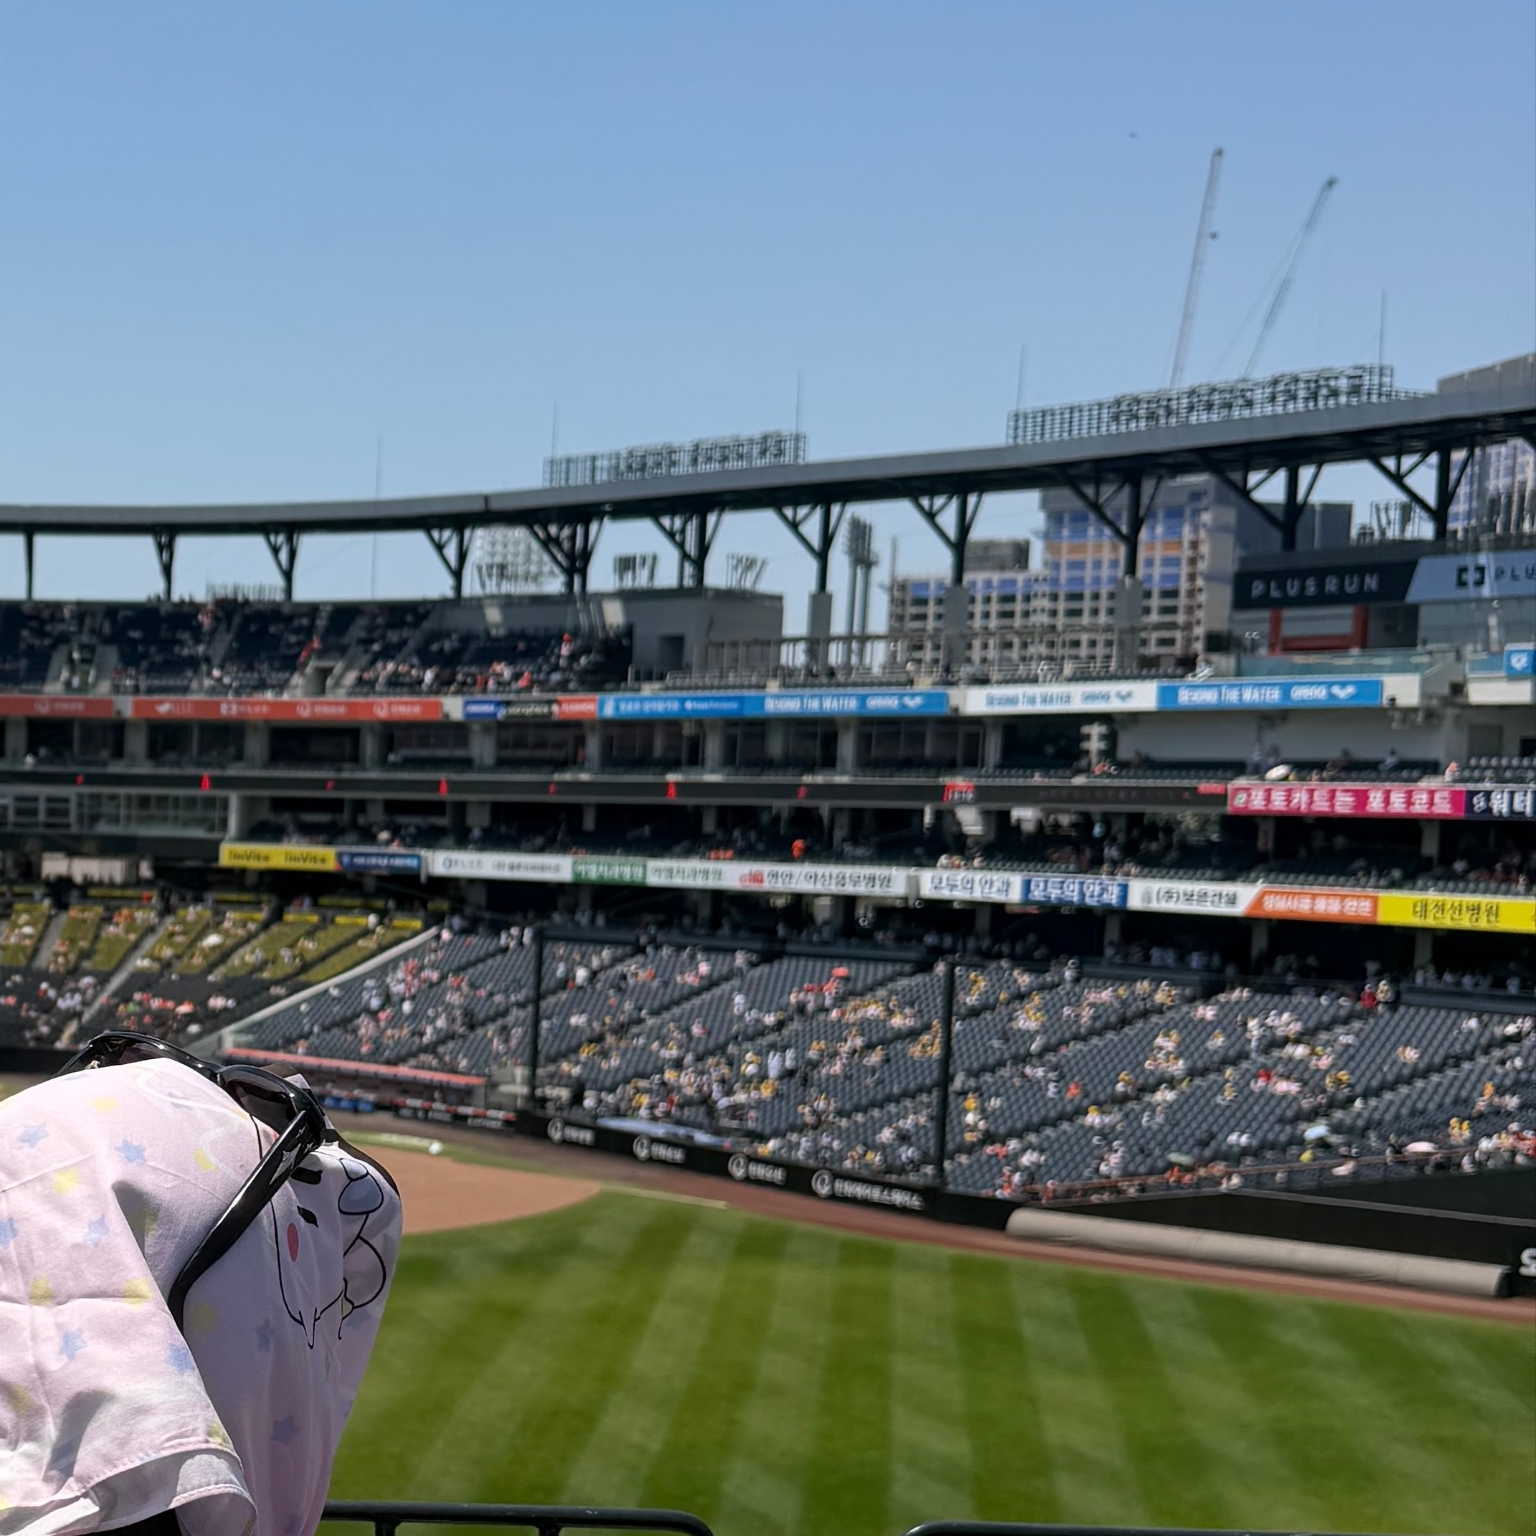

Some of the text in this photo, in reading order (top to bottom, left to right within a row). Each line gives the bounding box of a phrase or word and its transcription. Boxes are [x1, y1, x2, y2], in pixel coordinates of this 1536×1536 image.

[1250, 572, 1380, 599] PLUSRUN
[1247, 790, 1453, 812] 포토카드는 포토코드
[930, 874, 1012, 898] 모두의 안과
[1029, 878, 1120, 905] 모두의 안과
[1411, 901, 1501, 925] 대전선병원
